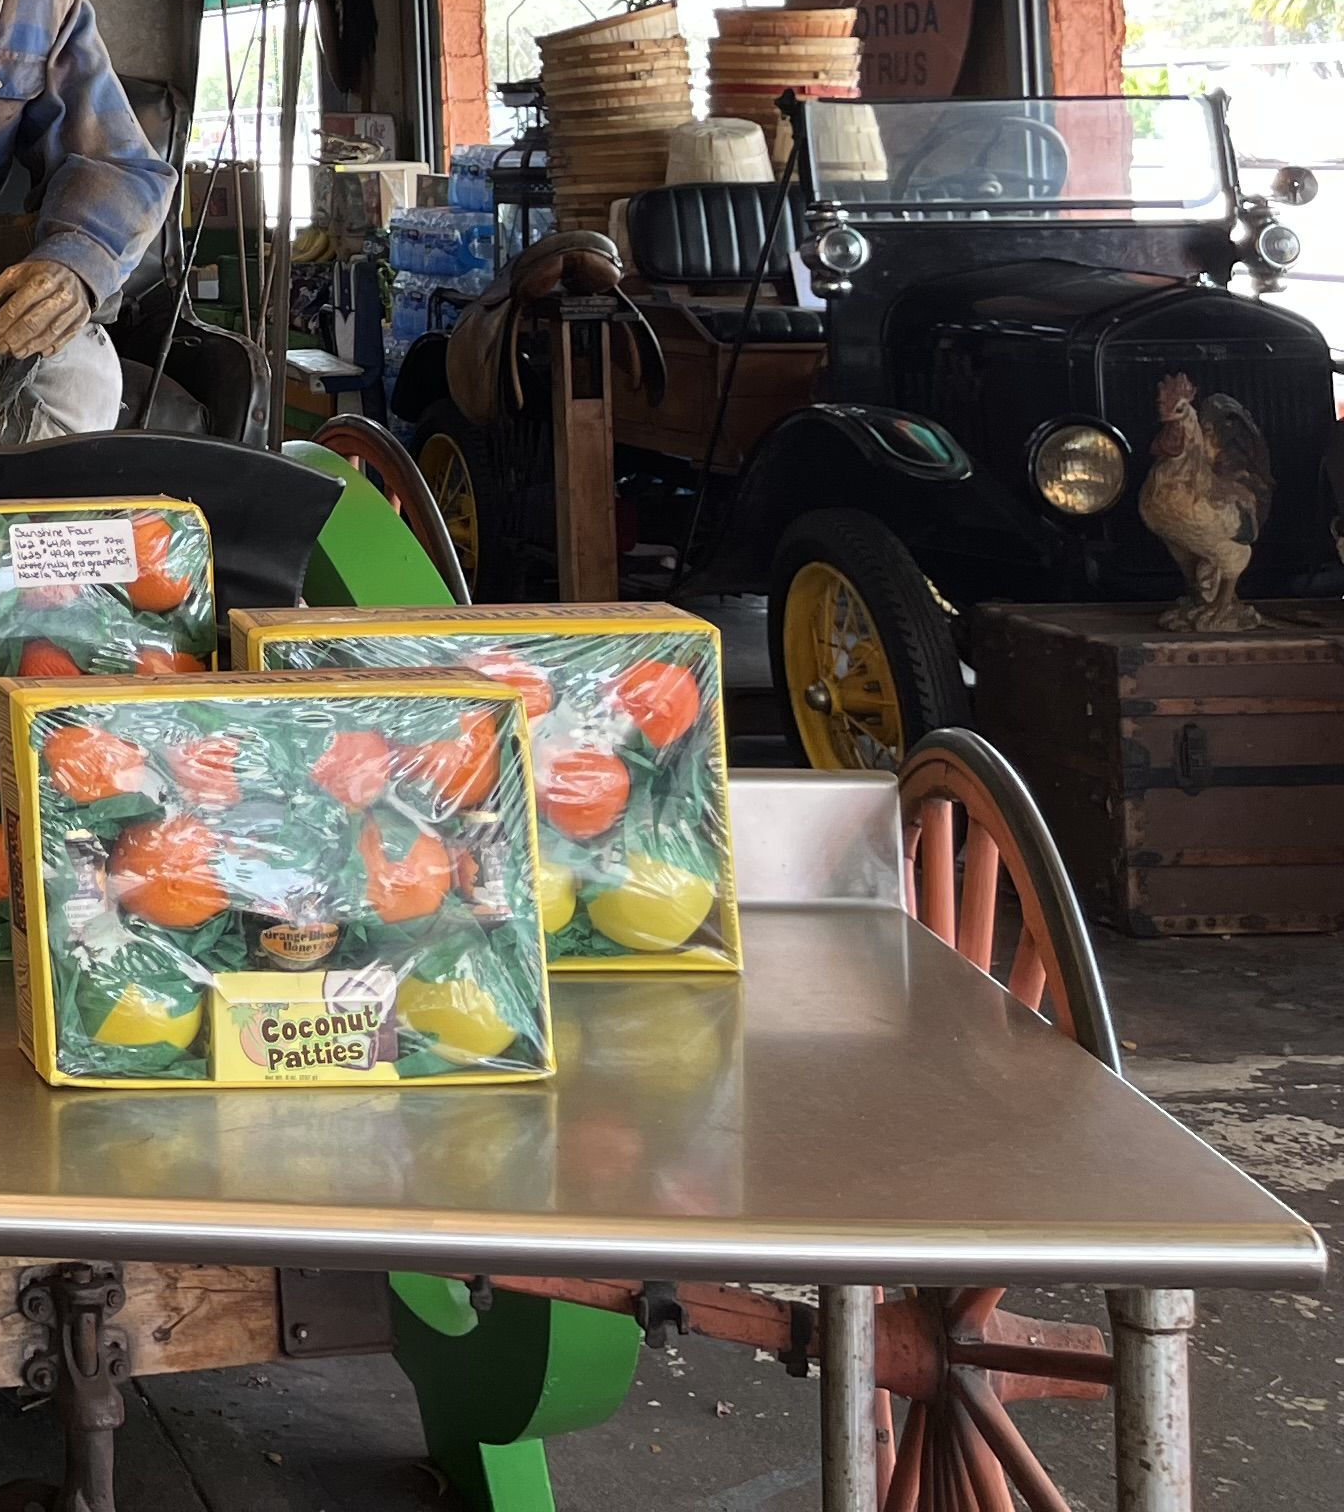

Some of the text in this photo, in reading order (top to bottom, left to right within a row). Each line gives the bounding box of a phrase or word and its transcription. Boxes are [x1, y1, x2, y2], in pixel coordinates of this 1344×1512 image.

[858, 0, 940, 38] ORIDA
[861, 51, 928, 87] TRUS
[15, 527, 63, 538] Sunshine
[264, 931, 306, 942] Orange
[261, 1005, 379, 1043] Coconut
[267, 1041, 364, 1070] Patties
